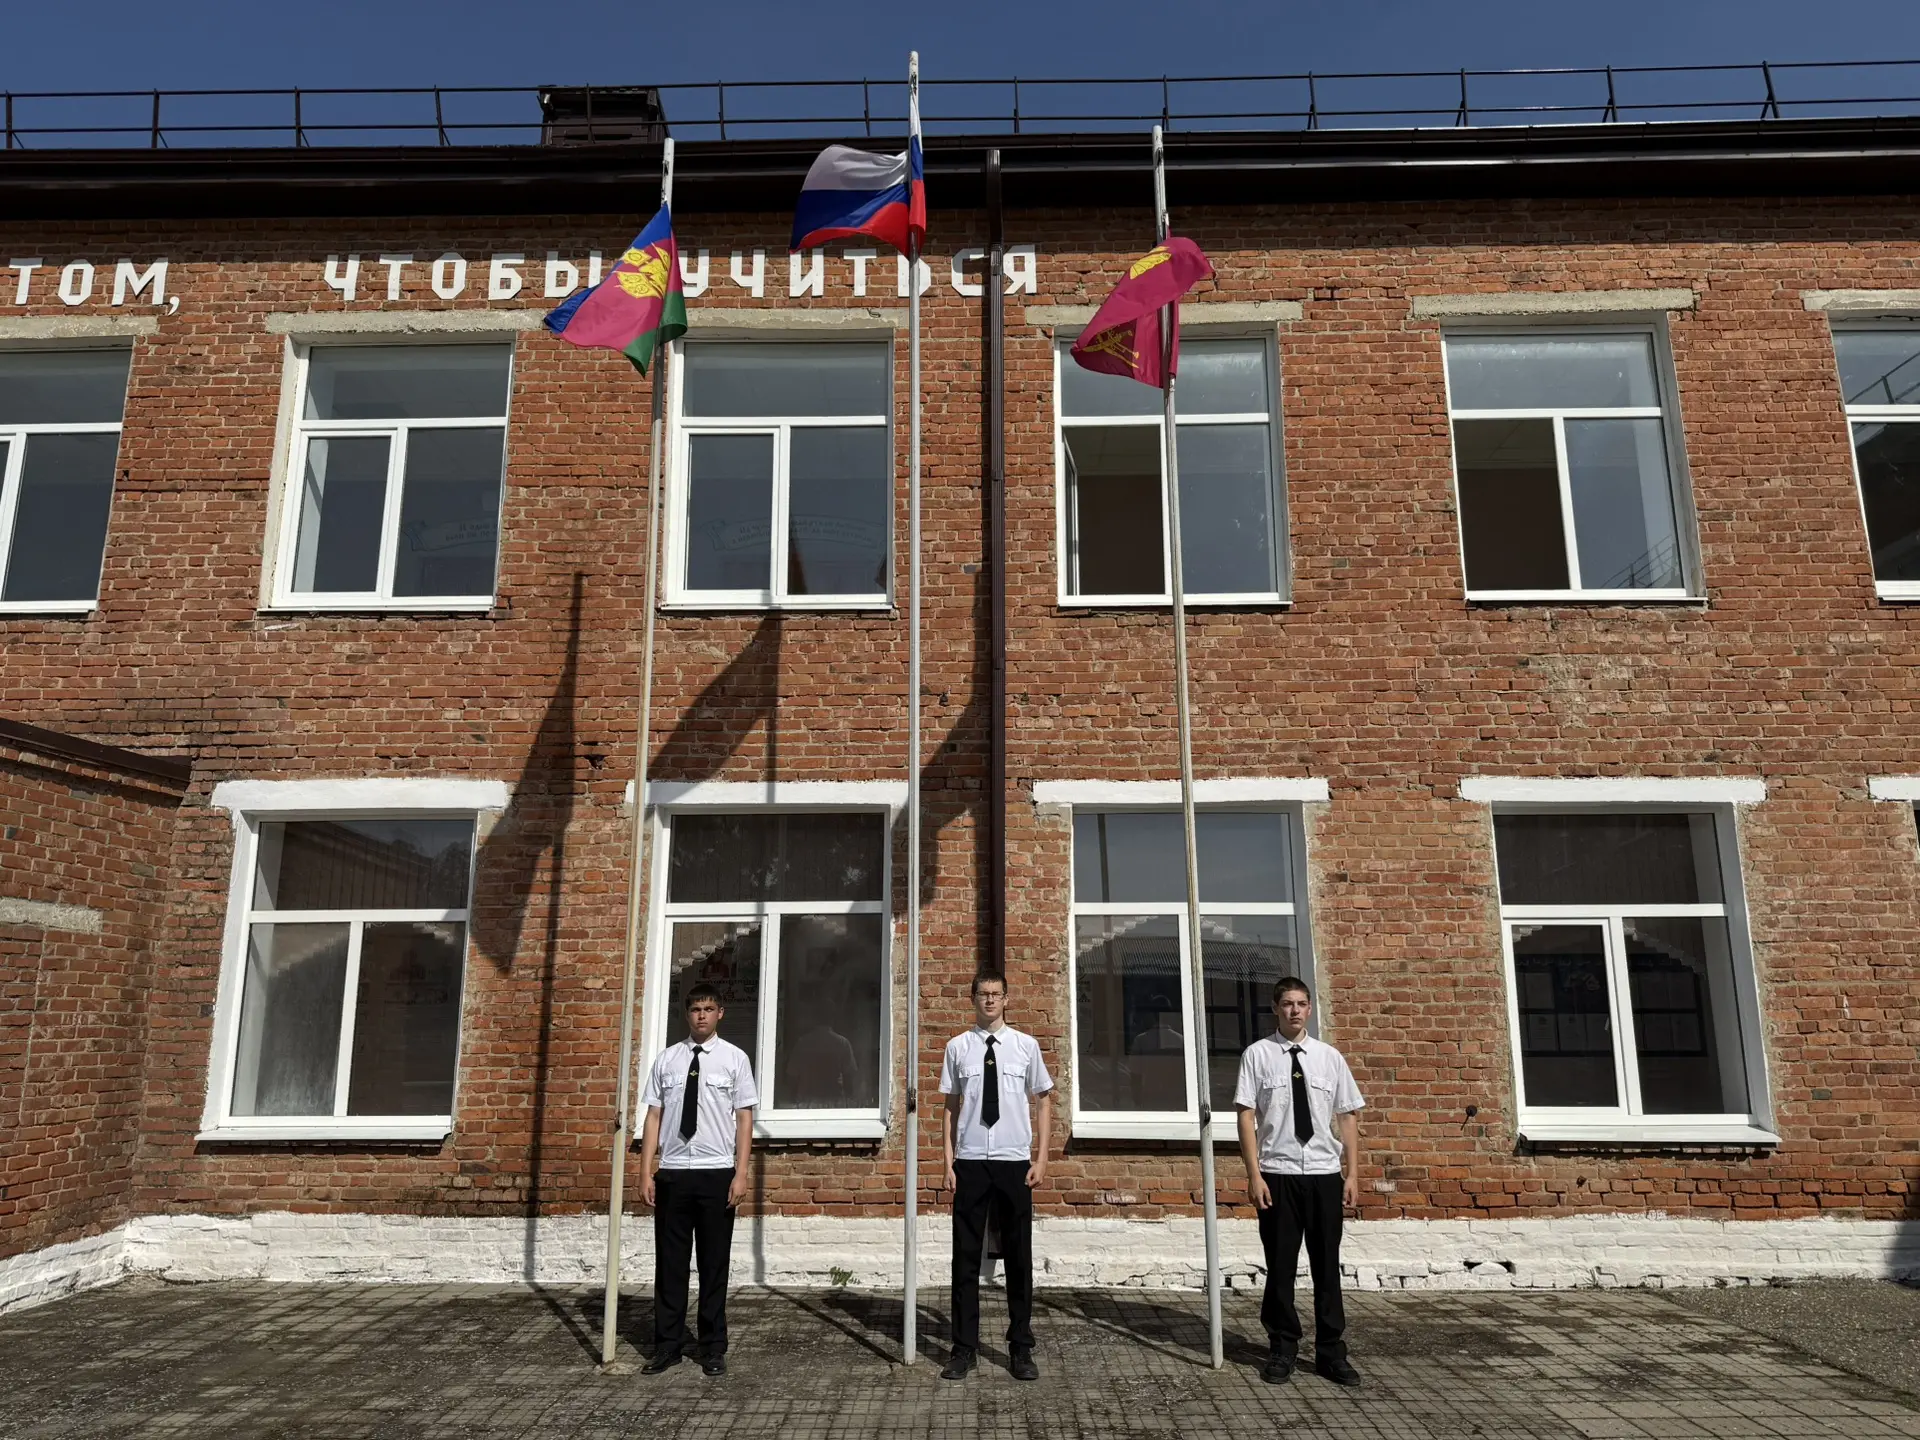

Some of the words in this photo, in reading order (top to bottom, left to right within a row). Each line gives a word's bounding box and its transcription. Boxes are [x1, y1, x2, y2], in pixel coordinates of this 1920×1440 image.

[9, 257, 180, 316] ТОМ,
[323, 250, 602, 301] ЧТОБЫ
[678, 244, 1037, 299] УЧИТЬСЯ
